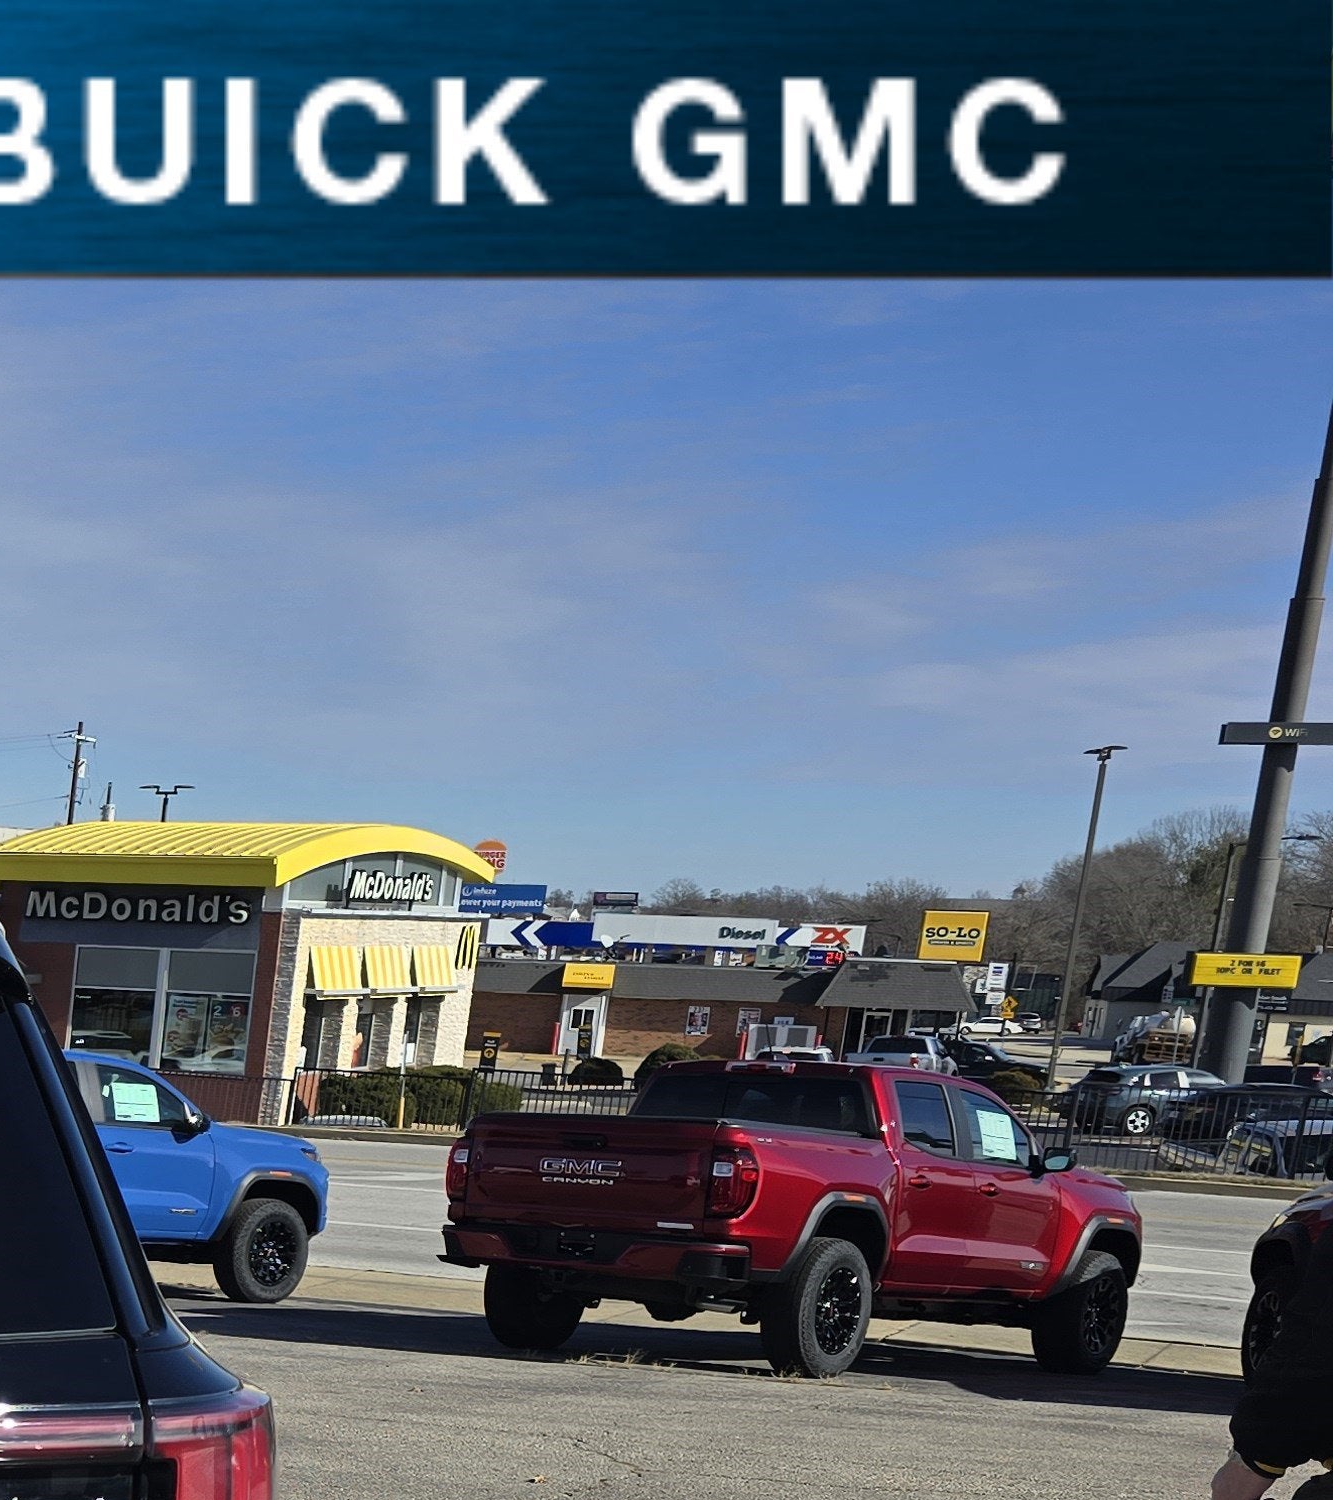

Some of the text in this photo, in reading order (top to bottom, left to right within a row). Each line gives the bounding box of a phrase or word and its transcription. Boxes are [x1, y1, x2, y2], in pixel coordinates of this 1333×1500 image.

[349, 870, 434, 900] McDonald's
[25, 890, 252, 924] McDonald's
[501, 900, 543, 908] payments
[719, 926, 766, 941] Diesel
[811, 927, 852, 945] ZX
[925, 926, 981, 939] SO-LO
[539, 1157, 623, 1177] GMC
[541, 1176, 614, 1186] CANYON
